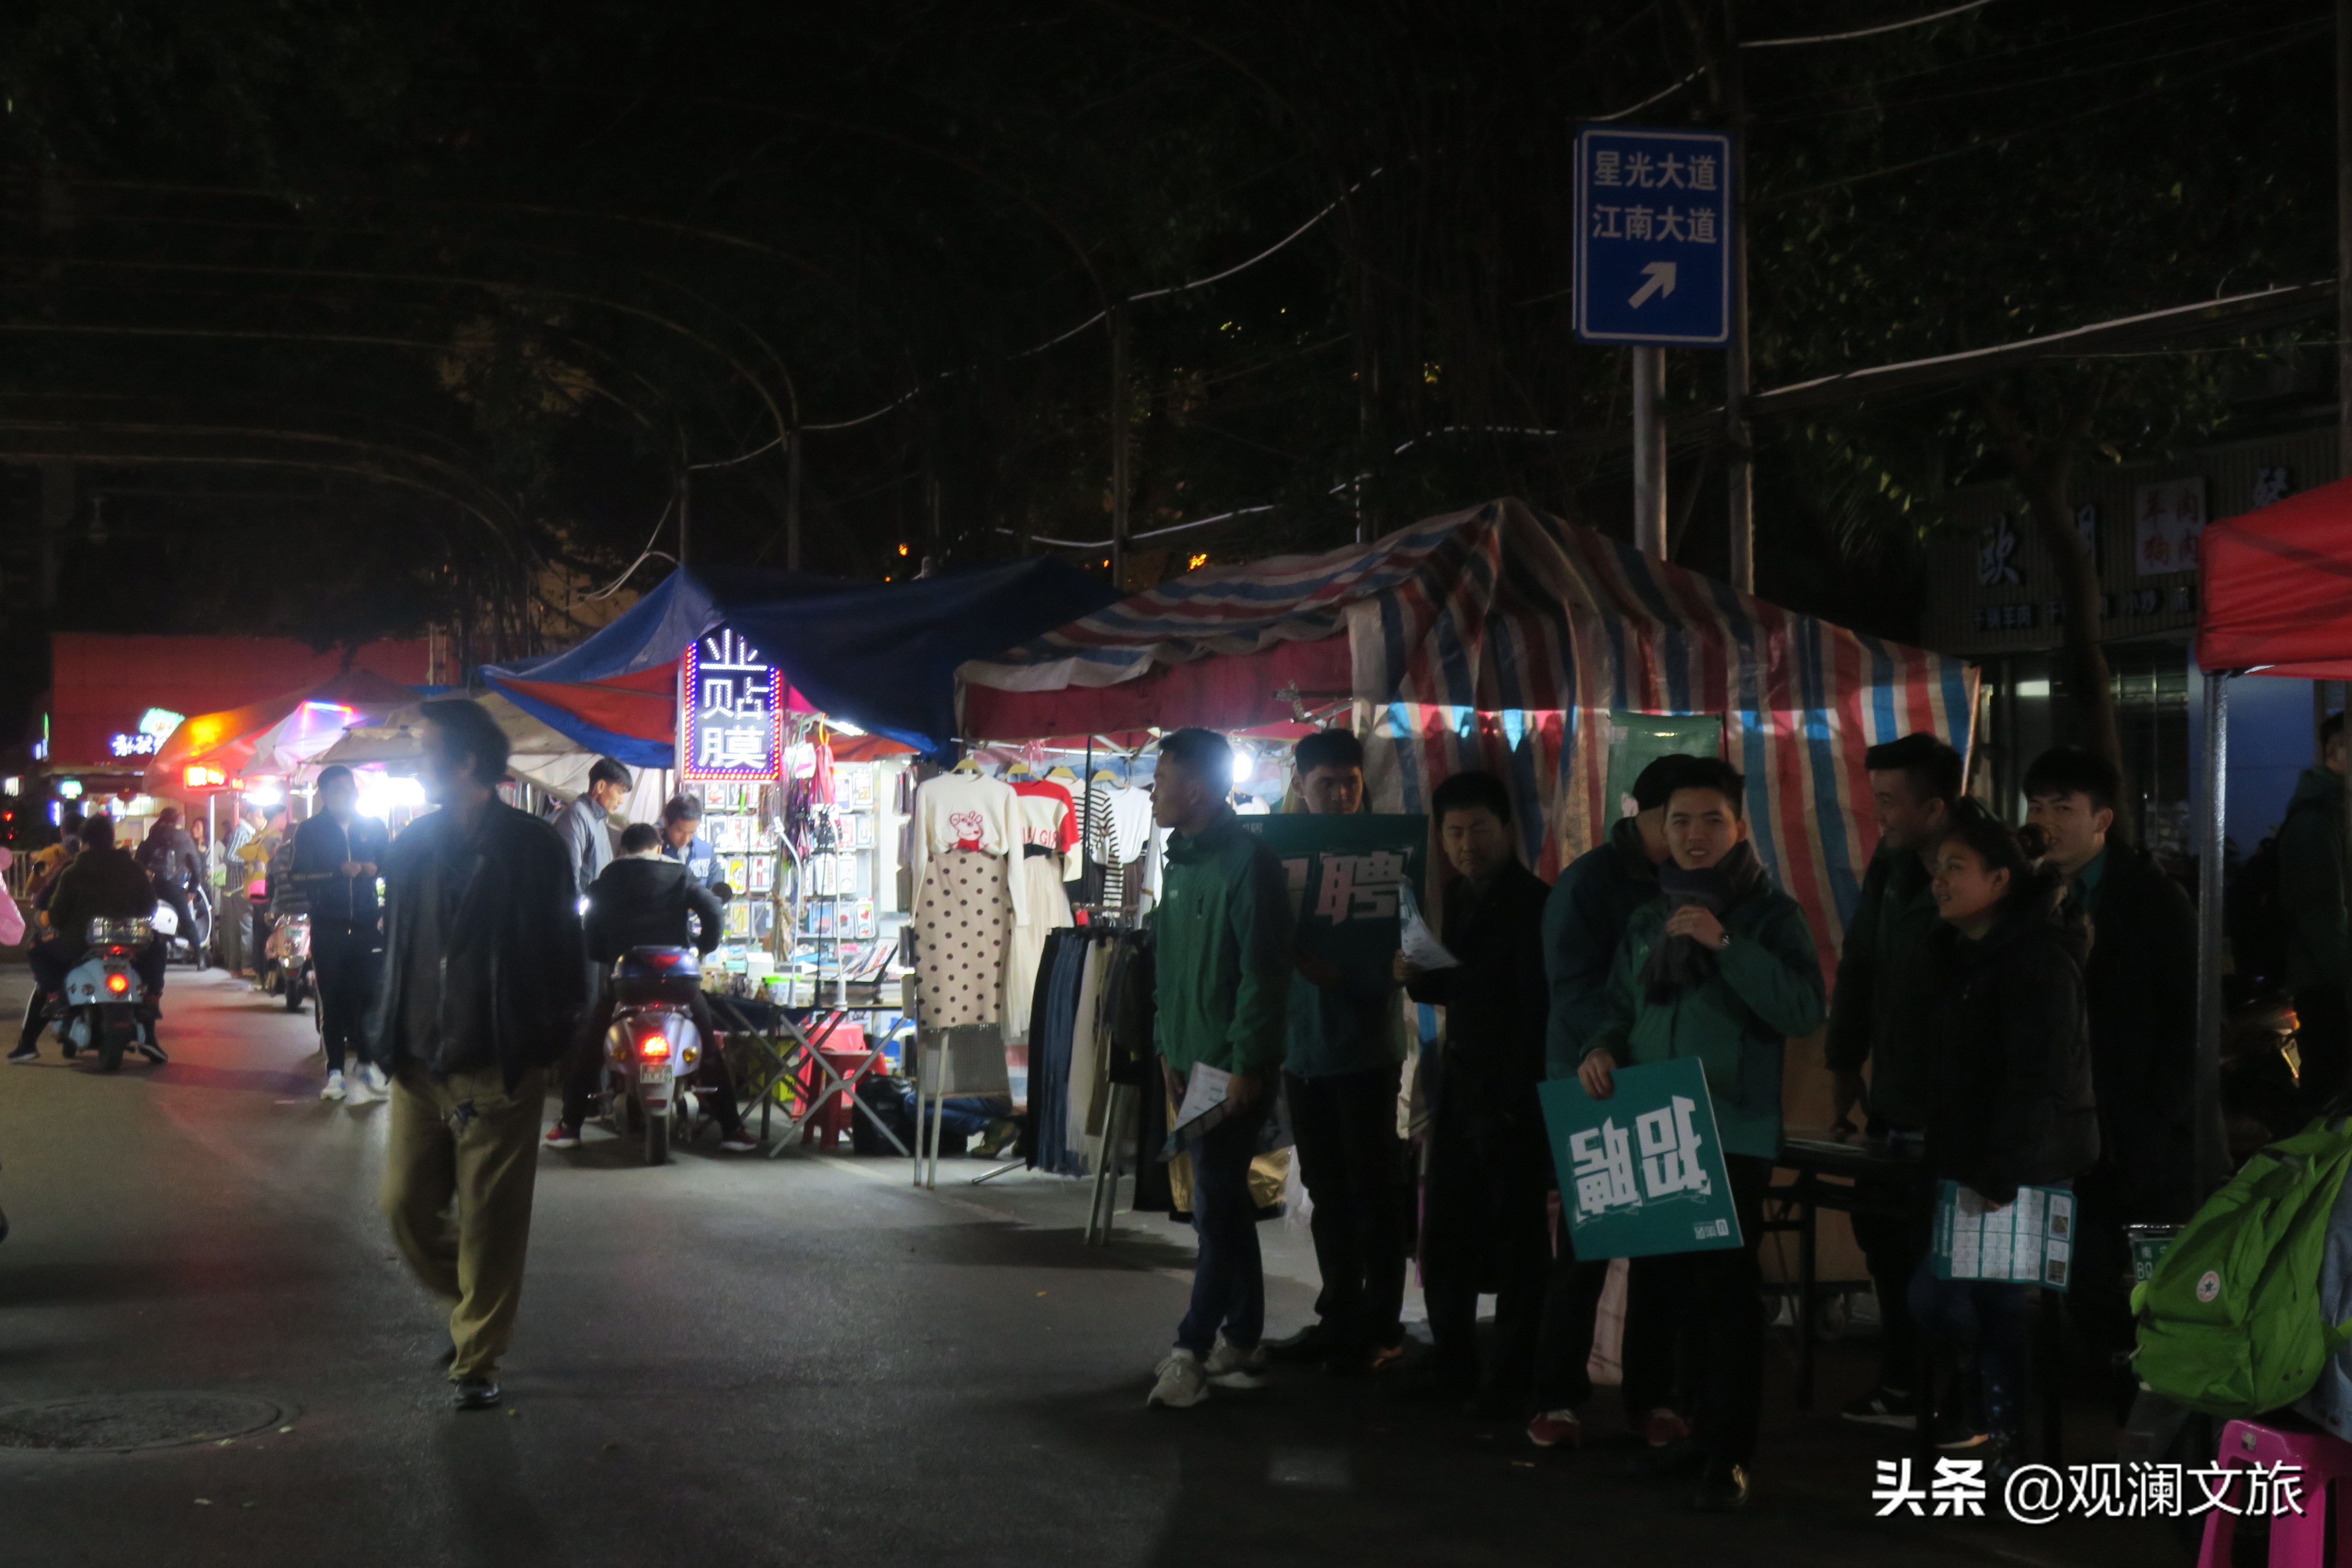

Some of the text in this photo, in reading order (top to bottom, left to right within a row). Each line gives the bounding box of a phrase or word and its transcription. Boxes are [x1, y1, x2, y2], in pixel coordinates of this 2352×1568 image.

[1593, 150, 1717, 190] 星光大道
[1592, 204, 1717, 243] 江南大道
[1282, 847, 1412, 926] 聘
[1569, 1094, 1712, 1223] 招聘
